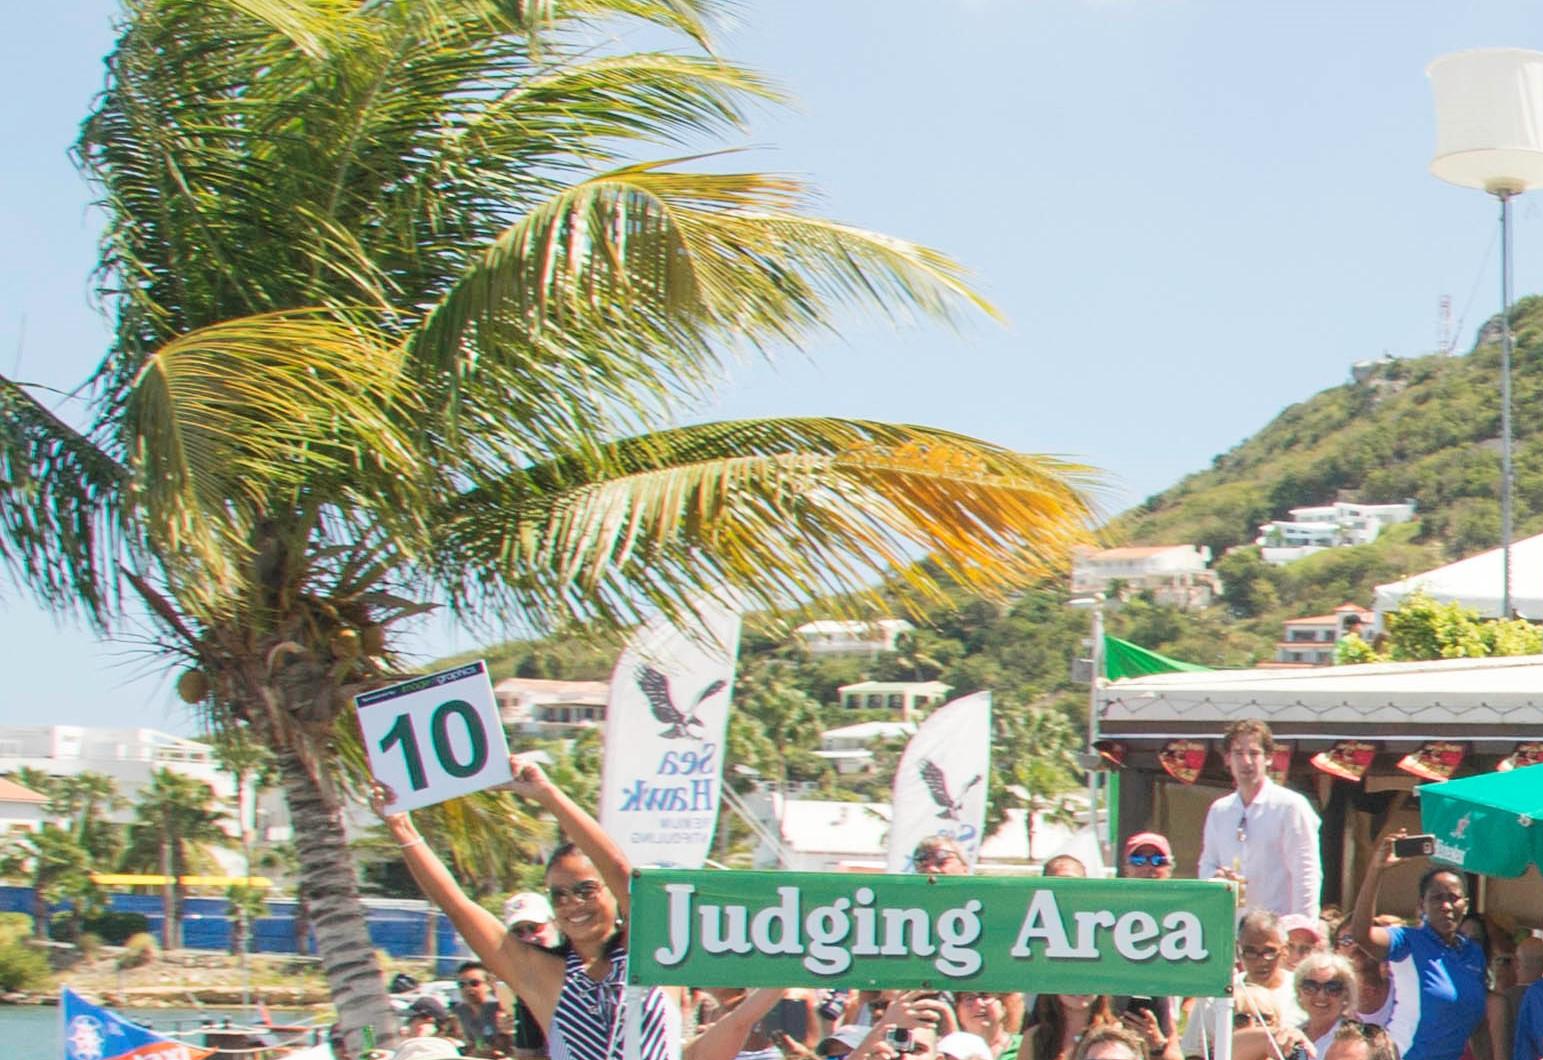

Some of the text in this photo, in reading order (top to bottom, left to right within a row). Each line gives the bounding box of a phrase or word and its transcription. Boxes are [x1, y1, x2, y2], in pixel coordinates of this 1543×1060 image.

[378, 698, 489, 792] 10
[655, 883, 1209, 977] Judging Area
